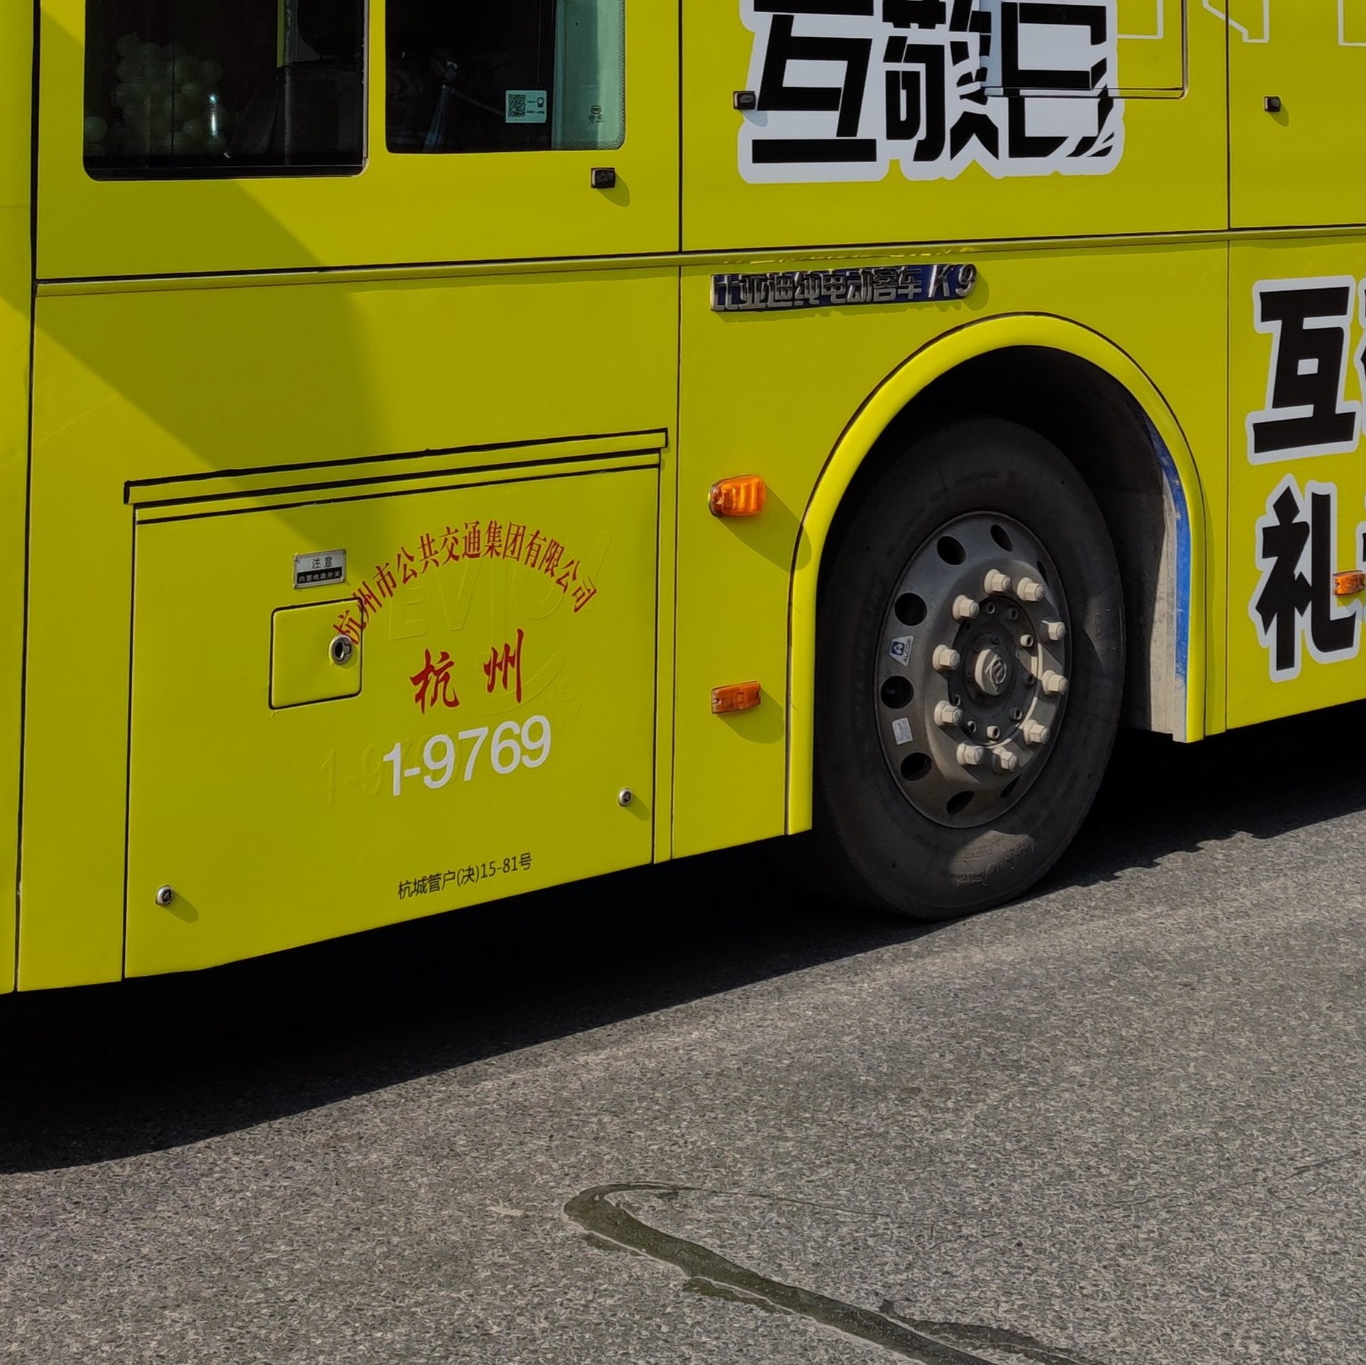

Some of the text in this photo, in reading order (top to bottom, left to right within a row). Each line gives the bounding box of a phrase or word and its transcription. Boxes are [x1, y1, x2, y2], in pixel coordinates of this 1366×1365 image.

[928, 262, 978, 299] K9
[333, 519, 598, 645] 杭州市公共交通集团有限公司
[409, 628, 525, 715] 杭州
[382, 715, 552, 797] 1-9769
